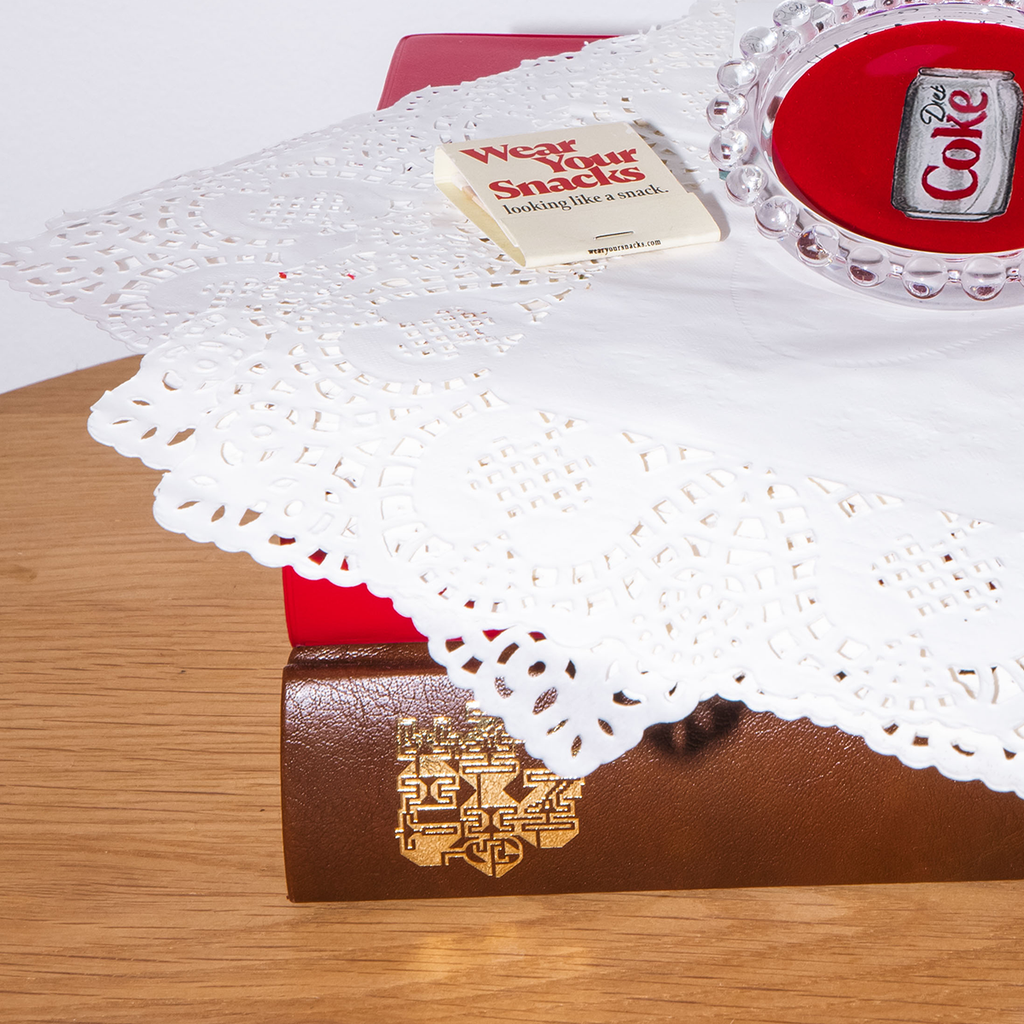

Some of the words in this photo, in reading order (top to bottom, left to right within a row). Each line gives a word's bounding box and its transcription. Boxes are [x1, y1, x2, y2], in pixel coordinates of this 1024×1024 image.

[920, 85, 946, 124] Diet
[459, 139, 576, 165] Wear
[534, 148, 637, 173] Your
[921, 90, 988, 201] Coke
[489, 166, 646, 201] Snacks
[502, 200, 572, 215] looking
[572, 193, 602, 206] like
[607, 192, 615, 202] a
[617, 184, 669, 199] snack.
[588, 240, 661, 255] wearyoursnacks.com
